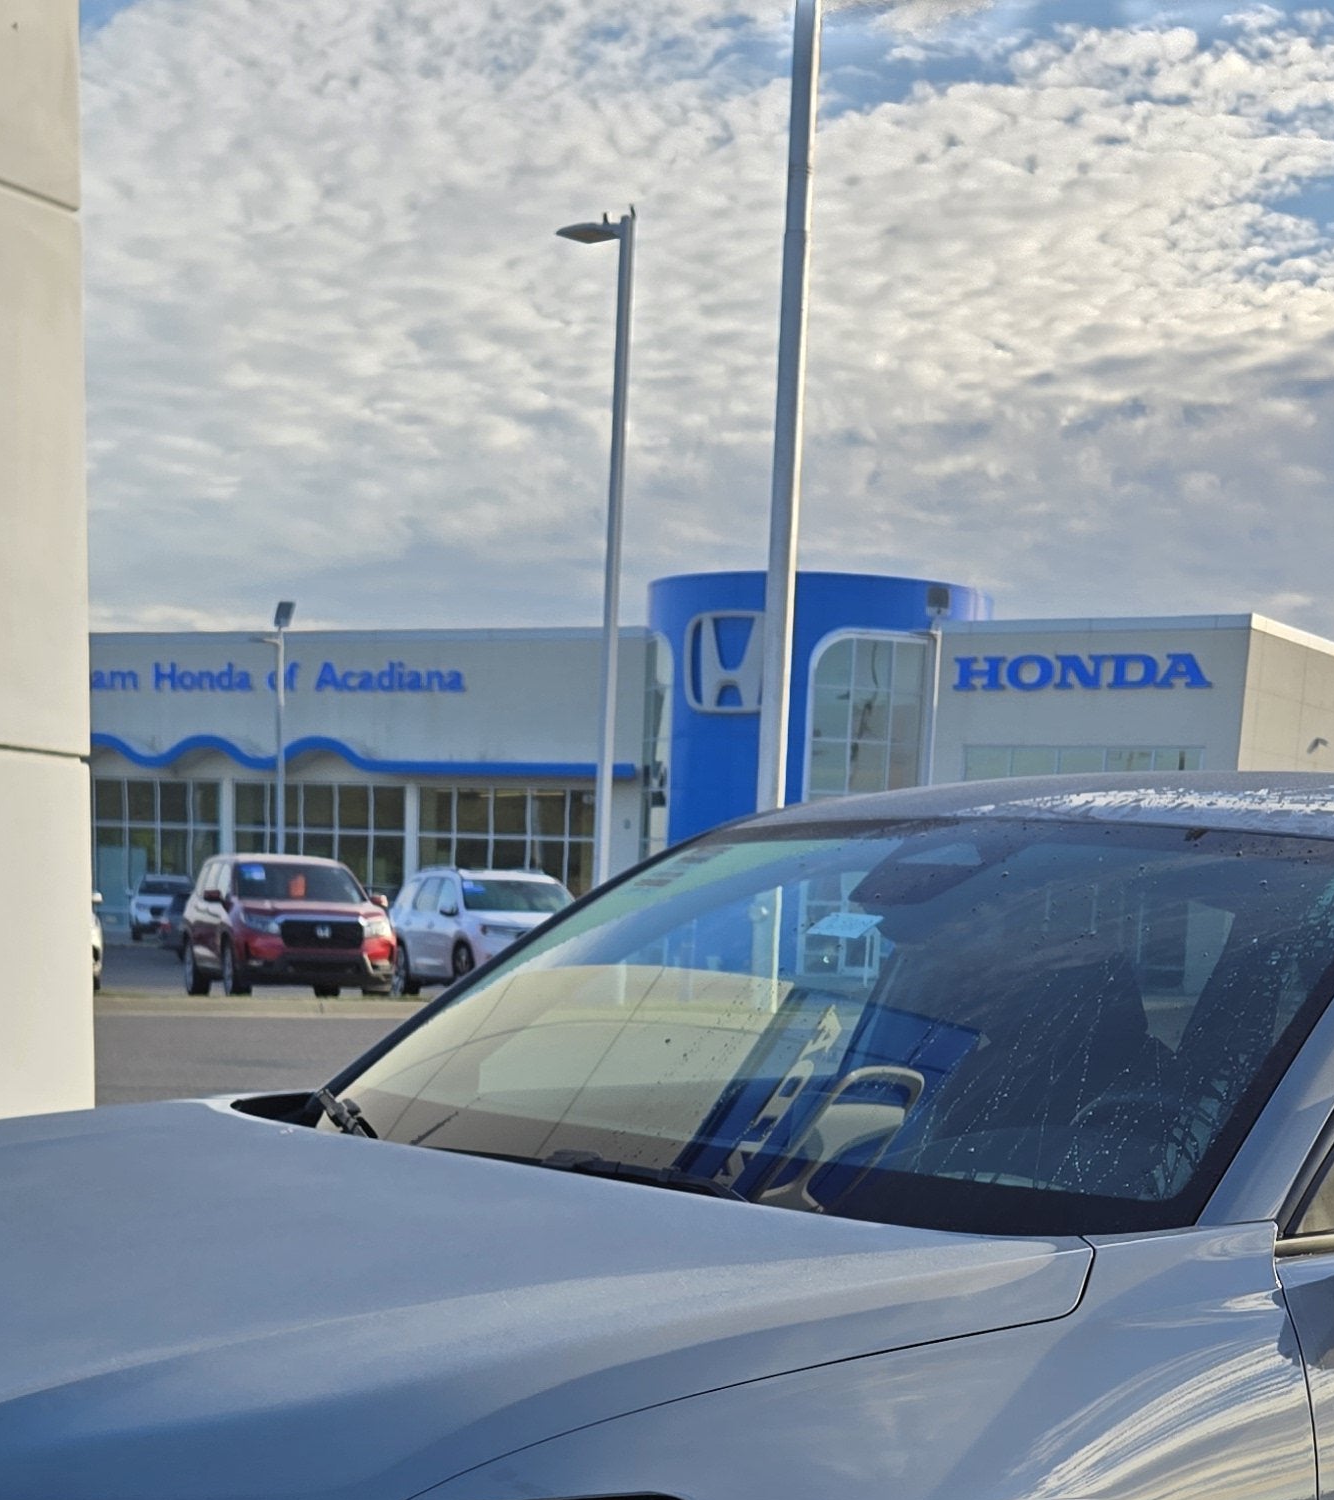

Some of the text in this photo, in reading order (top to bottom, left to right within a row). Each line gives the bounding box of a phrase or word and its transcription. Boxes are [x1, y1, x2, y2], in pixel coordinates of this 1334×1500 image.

[153, 661, 252, 692] Honda
[267, 661, 300, 692] of
[315, 661, 466, 692] Acadiana
[952, 653, 1213, 691] HONDA
